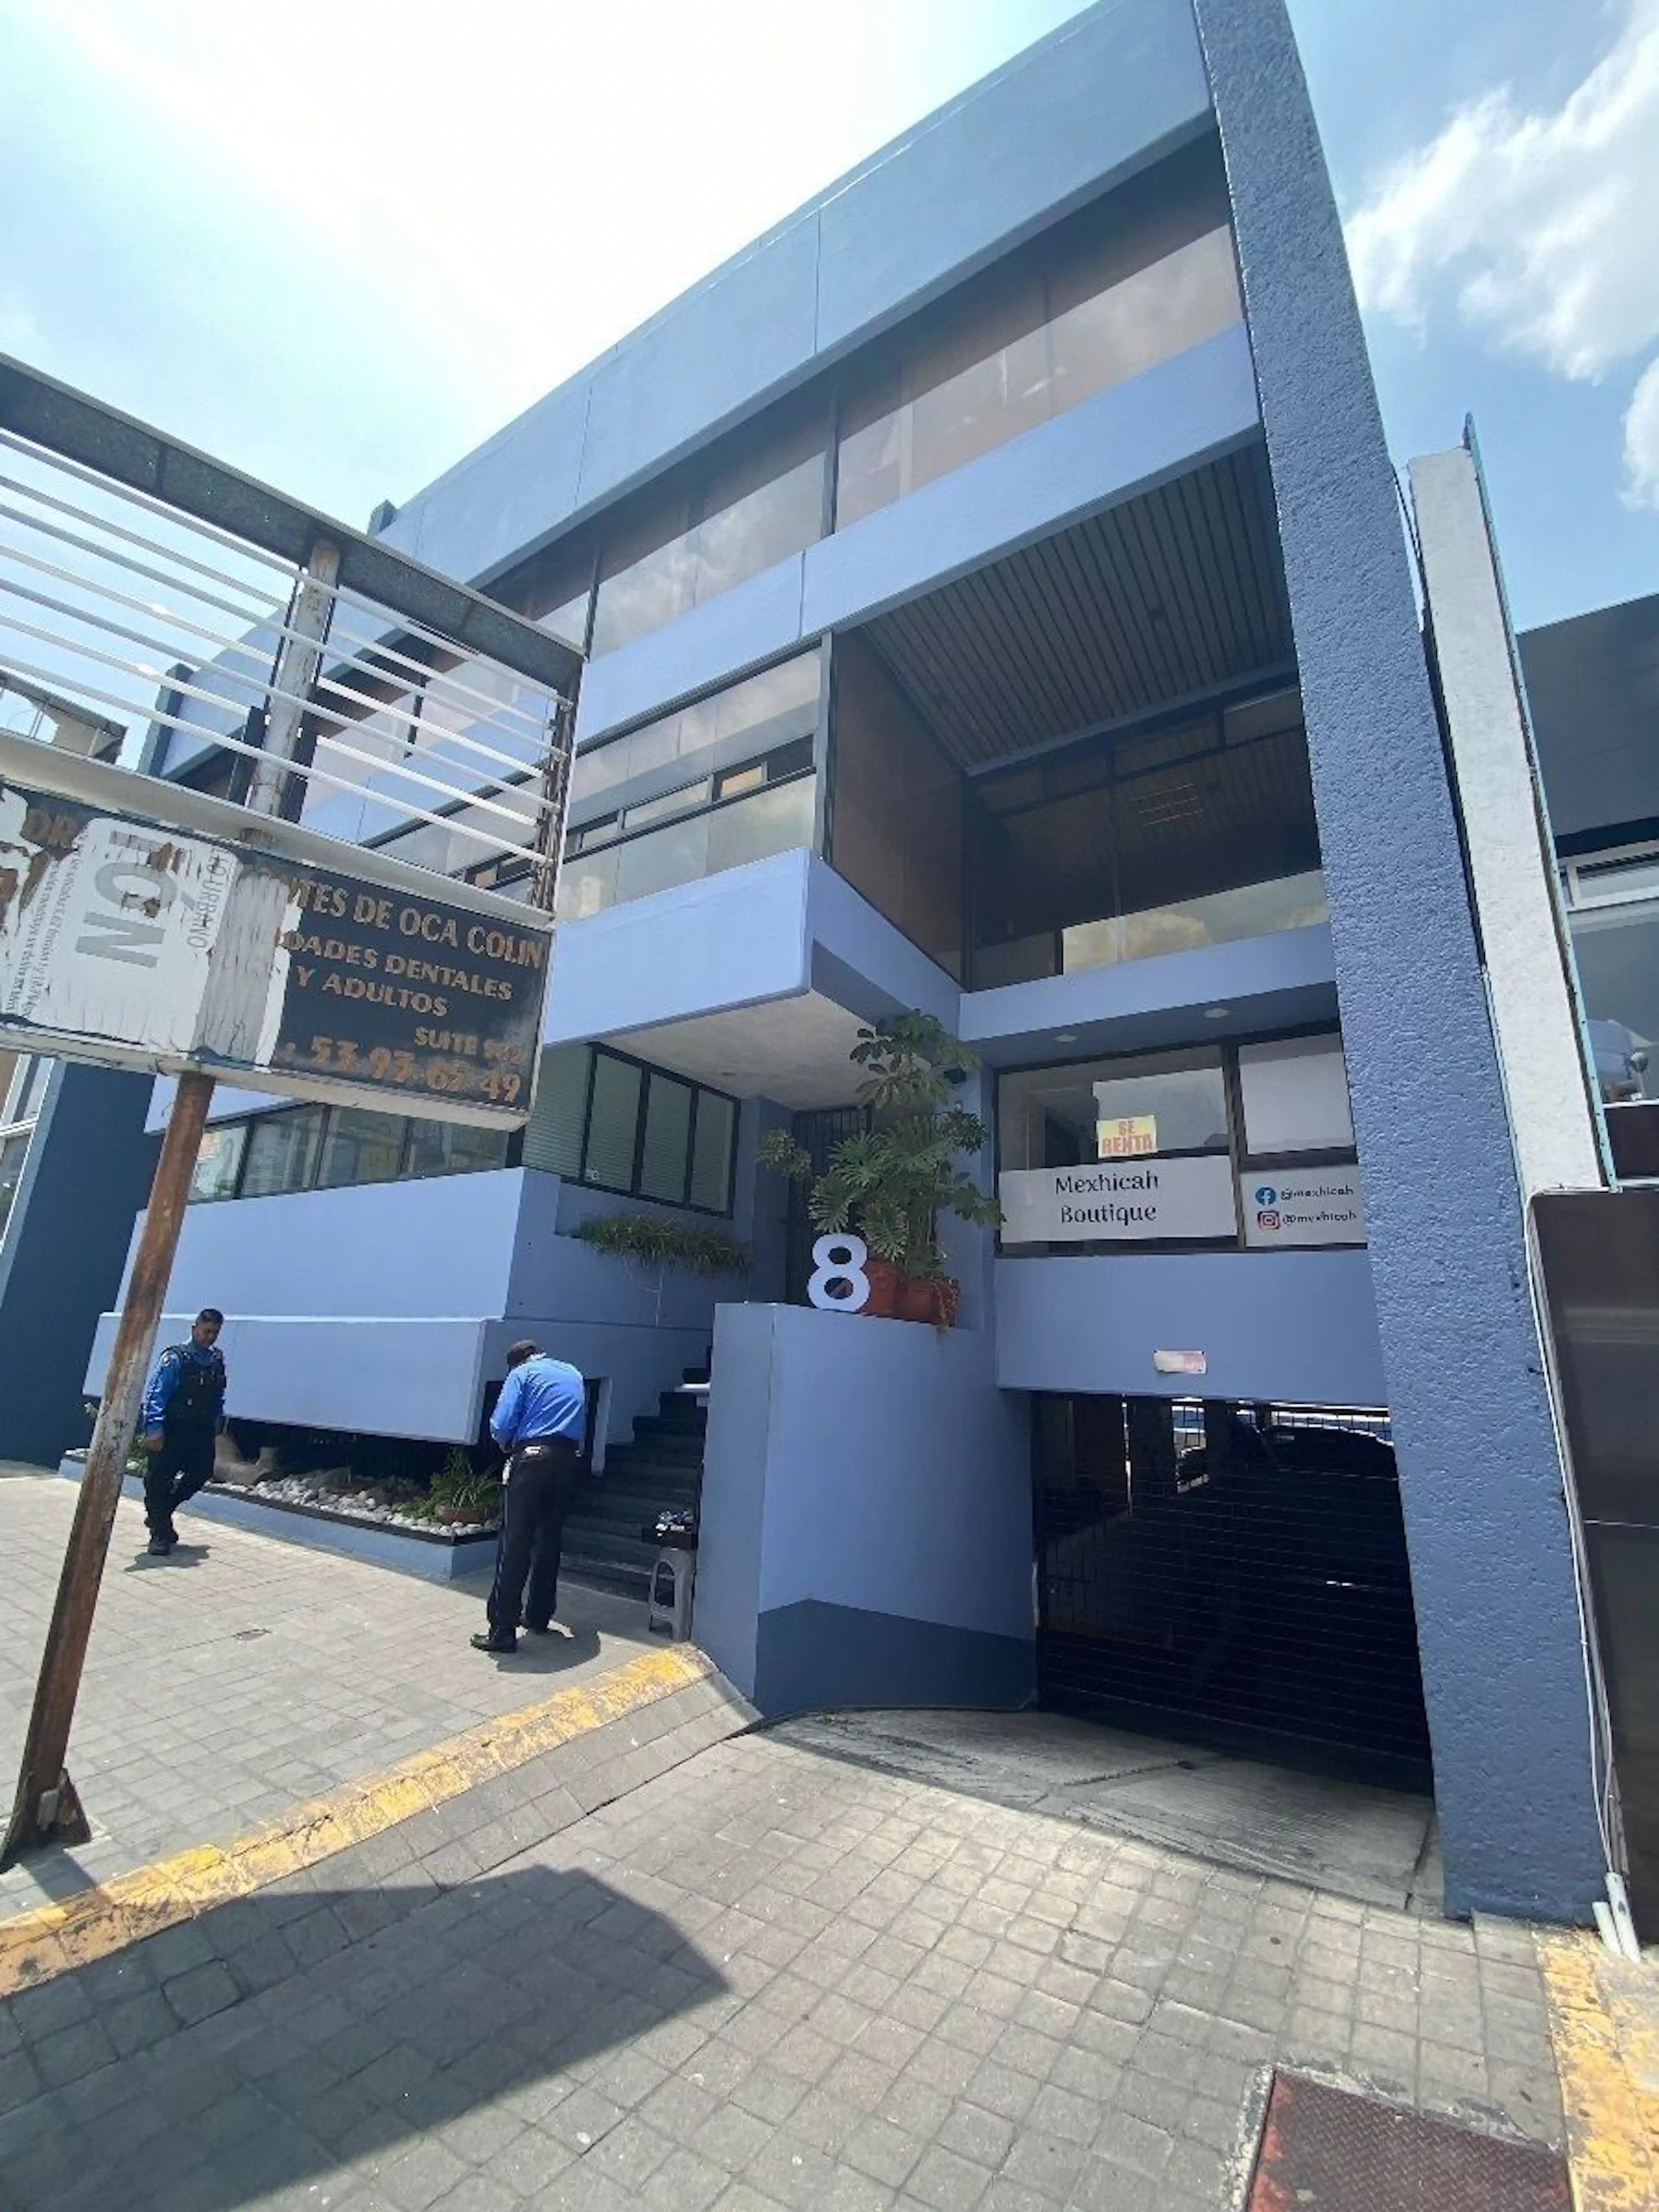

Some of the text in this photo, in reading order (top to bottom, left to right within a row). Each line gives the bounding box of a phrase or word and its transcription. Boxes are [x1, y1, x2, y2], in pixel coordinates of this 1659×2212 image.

[188, 879, 225, 949] URBANO
[353, 893, 393, 930] DE
[399, 906, 458, 948] OCA
[467, 925, 544, 969] COLIN
[296, 964, 448, 1017] Y ADULTOS
[385, 953, 513, 1001] DENTALES
[413, 1025, 477, 1055] SUITE
[1118, 1120, 1135, 1136] SE
[1102, 1134, 1152, 1154] RENTA
[1055, 1170, 1159, 1195] Mexhicah
[1281, 1184, 1354, 1200] @mexhicah
[1061, 1204, 1157, 1226] Boutique
[1282, 1210, 1357, 1225] @mexhicah
[807, 1233, 871, 1313] 8
